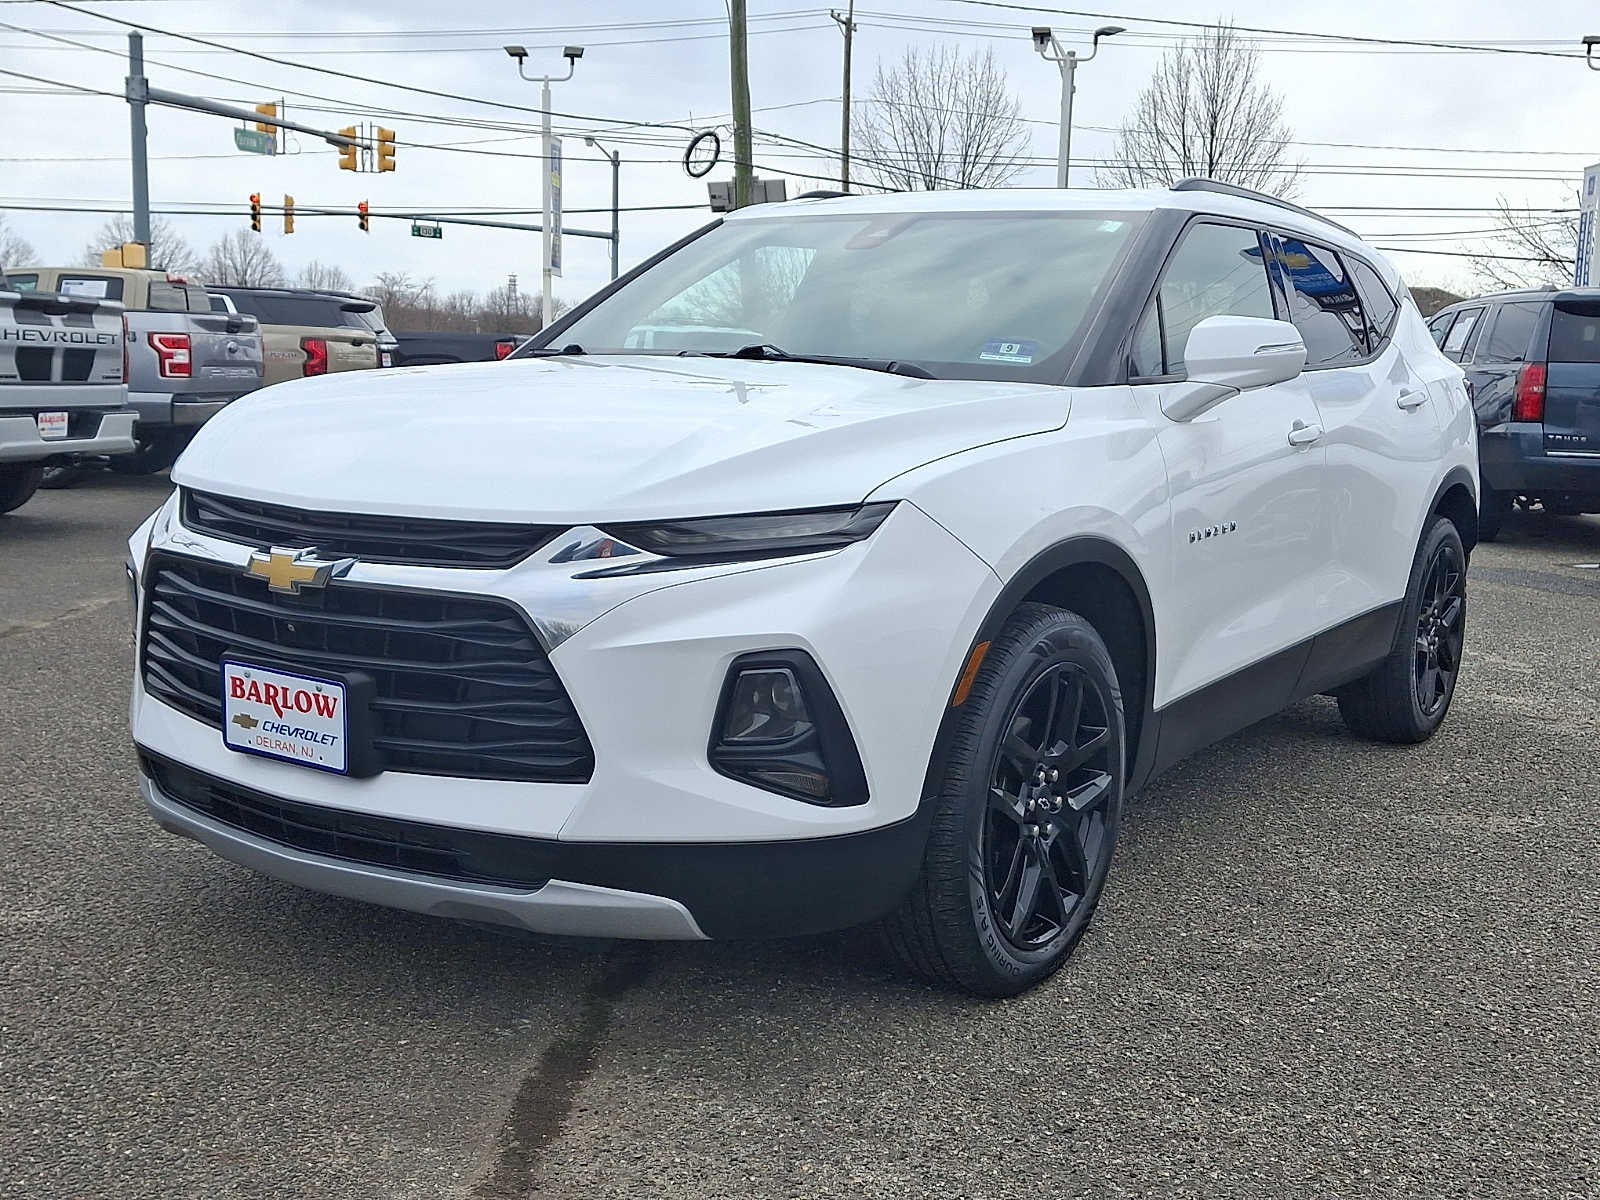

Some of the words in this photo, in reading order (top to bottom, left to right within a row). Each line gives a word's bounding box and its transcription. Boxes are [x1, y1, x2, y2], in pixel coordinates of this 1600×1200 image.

[0, 328, 118, 345] HEVROLET
[229, 675, 338, 719] BARLOW
[262, 720, 339, 747] CHEVROLET
[301, 745, 314, 759] NJ
